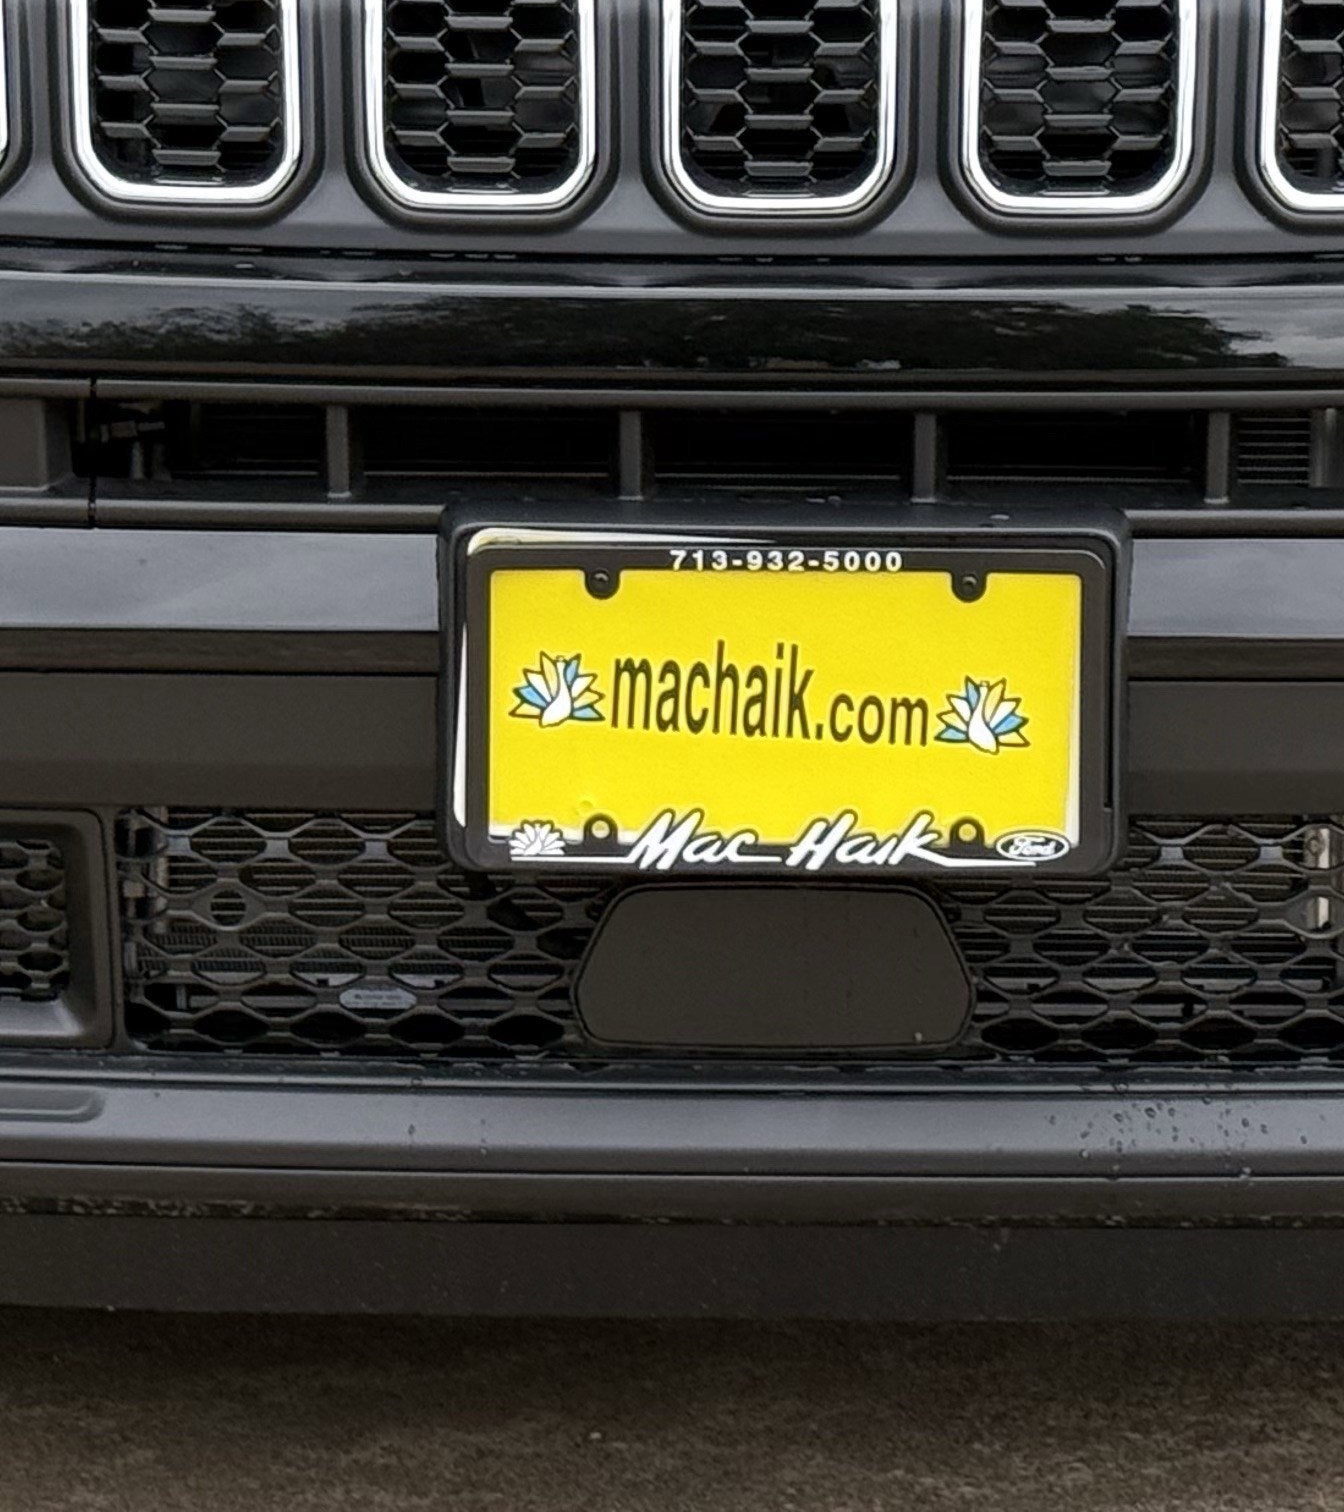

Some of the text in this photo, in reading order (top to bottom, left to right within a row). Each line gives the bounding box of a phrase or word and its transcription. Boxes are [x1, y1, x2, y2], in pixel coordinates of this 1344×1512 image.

[669, 549, 903, 572] 713-932-5000
[610, 639, 929, 746] machaik.com
[634, 809, 944, 870] Mac Haik
[1009, 836, 1056, 856] Ford
